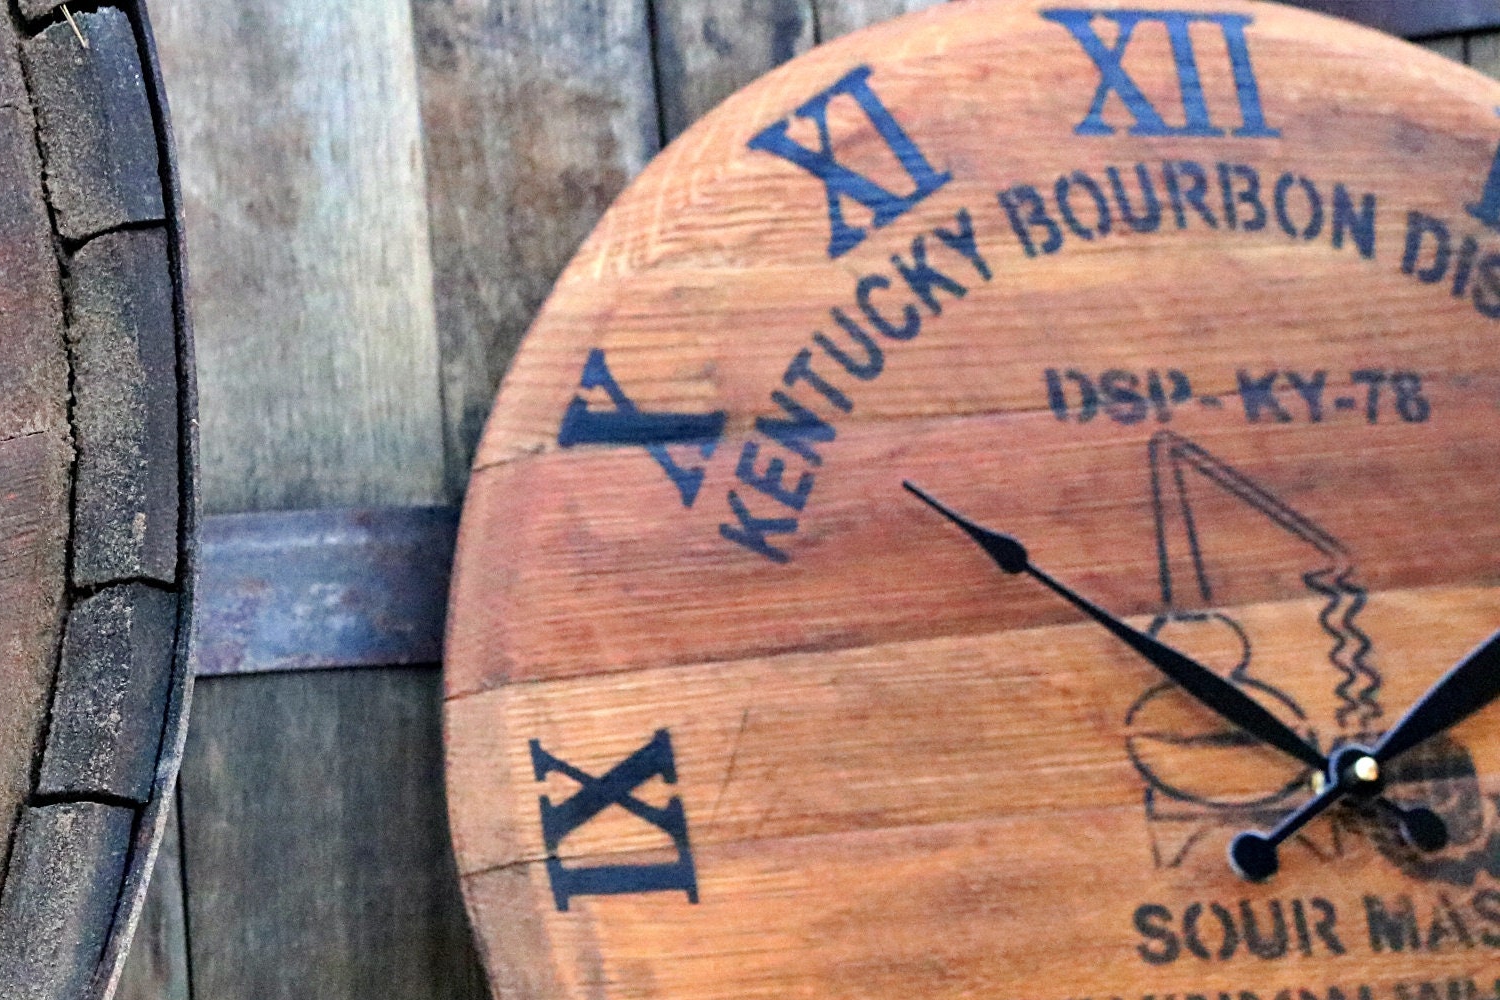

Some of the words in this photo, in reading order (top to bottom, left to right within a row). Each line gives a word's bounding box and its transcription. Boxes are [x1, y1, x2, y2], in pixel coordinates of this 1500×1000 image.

[1039, 6, 1283, 139] XII
[748, 64, 953, 259] XI
[558, 347, 726, 507] X
[719, 208, 995, 564] KENTUCKY
[997, 160, 1378, 259] BOURBON
[528, 727, 699, 913] IX
[1132, 897, 1347, 965] SOUR
